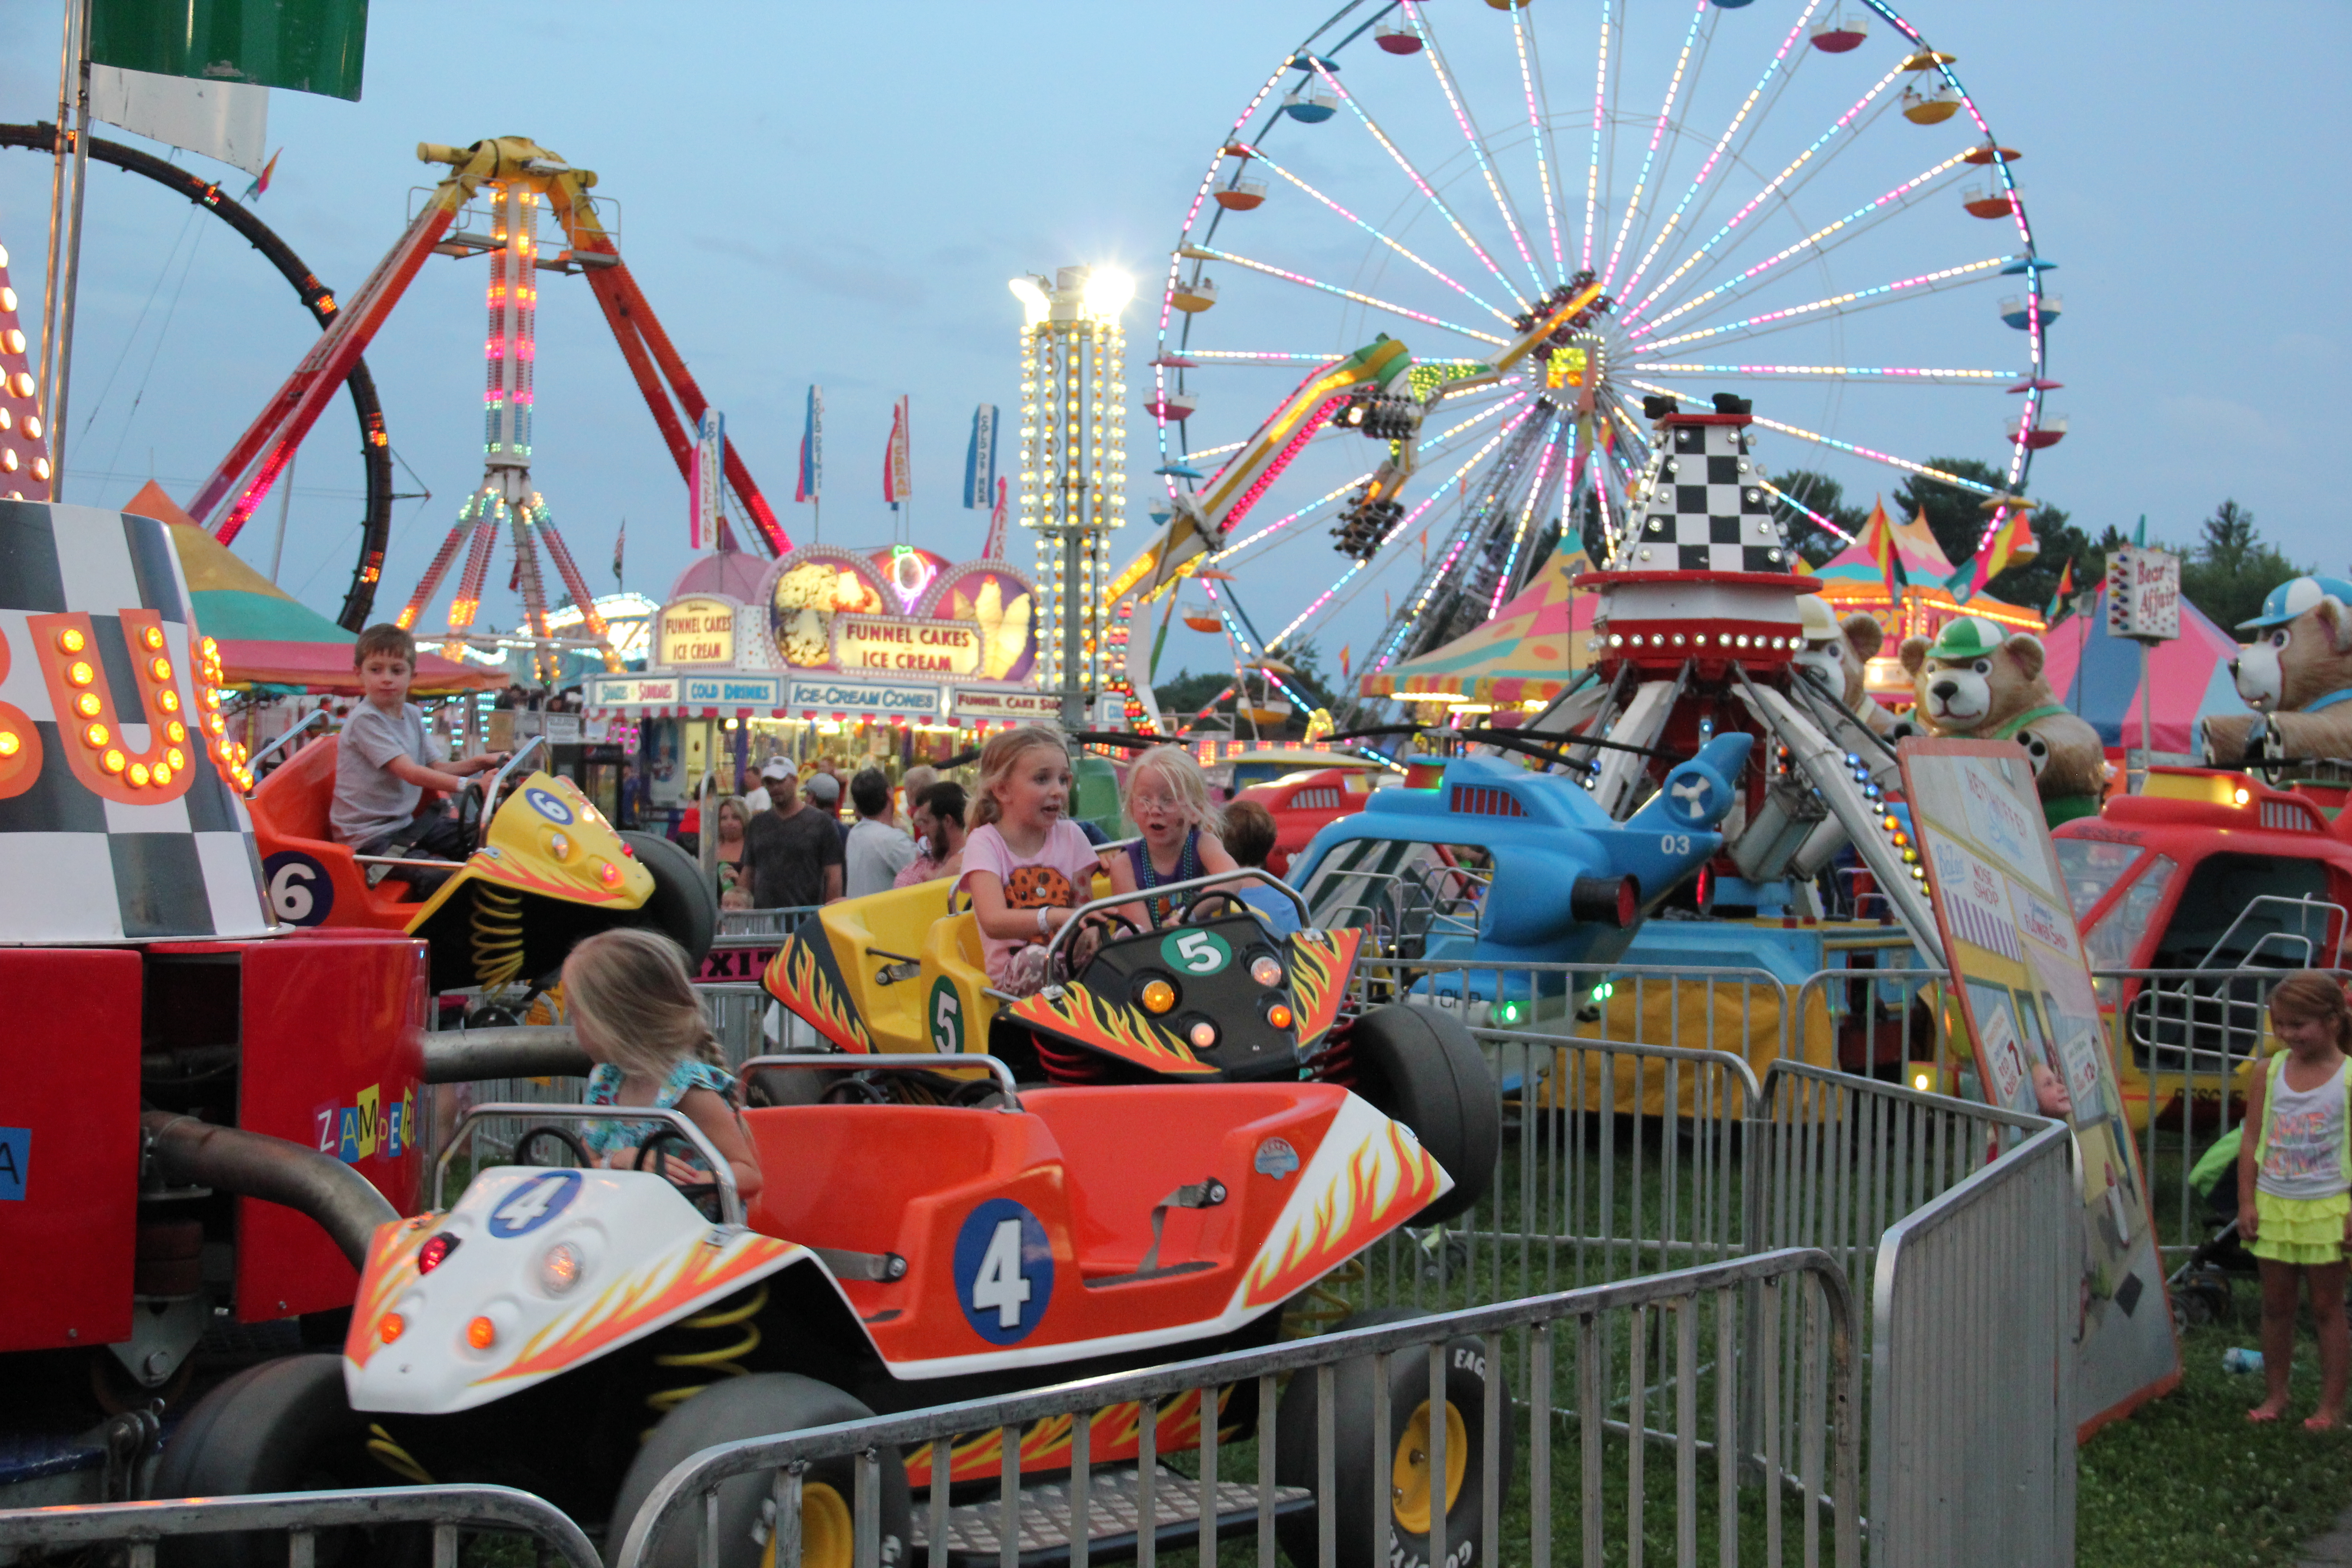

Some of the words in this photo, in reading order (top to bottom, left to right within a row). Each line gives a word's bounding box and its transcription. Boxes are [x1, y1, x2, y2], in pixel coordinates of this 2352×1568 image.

[666, 616, 701, 634] FUNNEL
[705, 615, 732, 632] CAKES
[847, 623, 913, 643] FUNNEL
[920, 628, 970, 647] CAKES
[673, 642, 687, 660] ICE
[691, 642, 721, 659] CREAM
[863, 650, 889, 668] ICE
[896, 653, 952, 671] CREAM
[691, 683, 719, 699] COLD
[725, 683, 770, 701] DRINKS
[532, 792, 568, 821] 6
[1661, 834, 1690, 855] 03
[1972, 862, 1994, 888] NOSE
[270, 862, 316, 921] 6
[1974, 881, 1999, 907] SHOP
[708, 951, 776, 976] XIT
[1176, 931, 1223, 972] 5
[936, 991, 957, 1054] 5
[494, 1175, 570, 1230] 4
[972, 1219, 1031, 1328] 4
